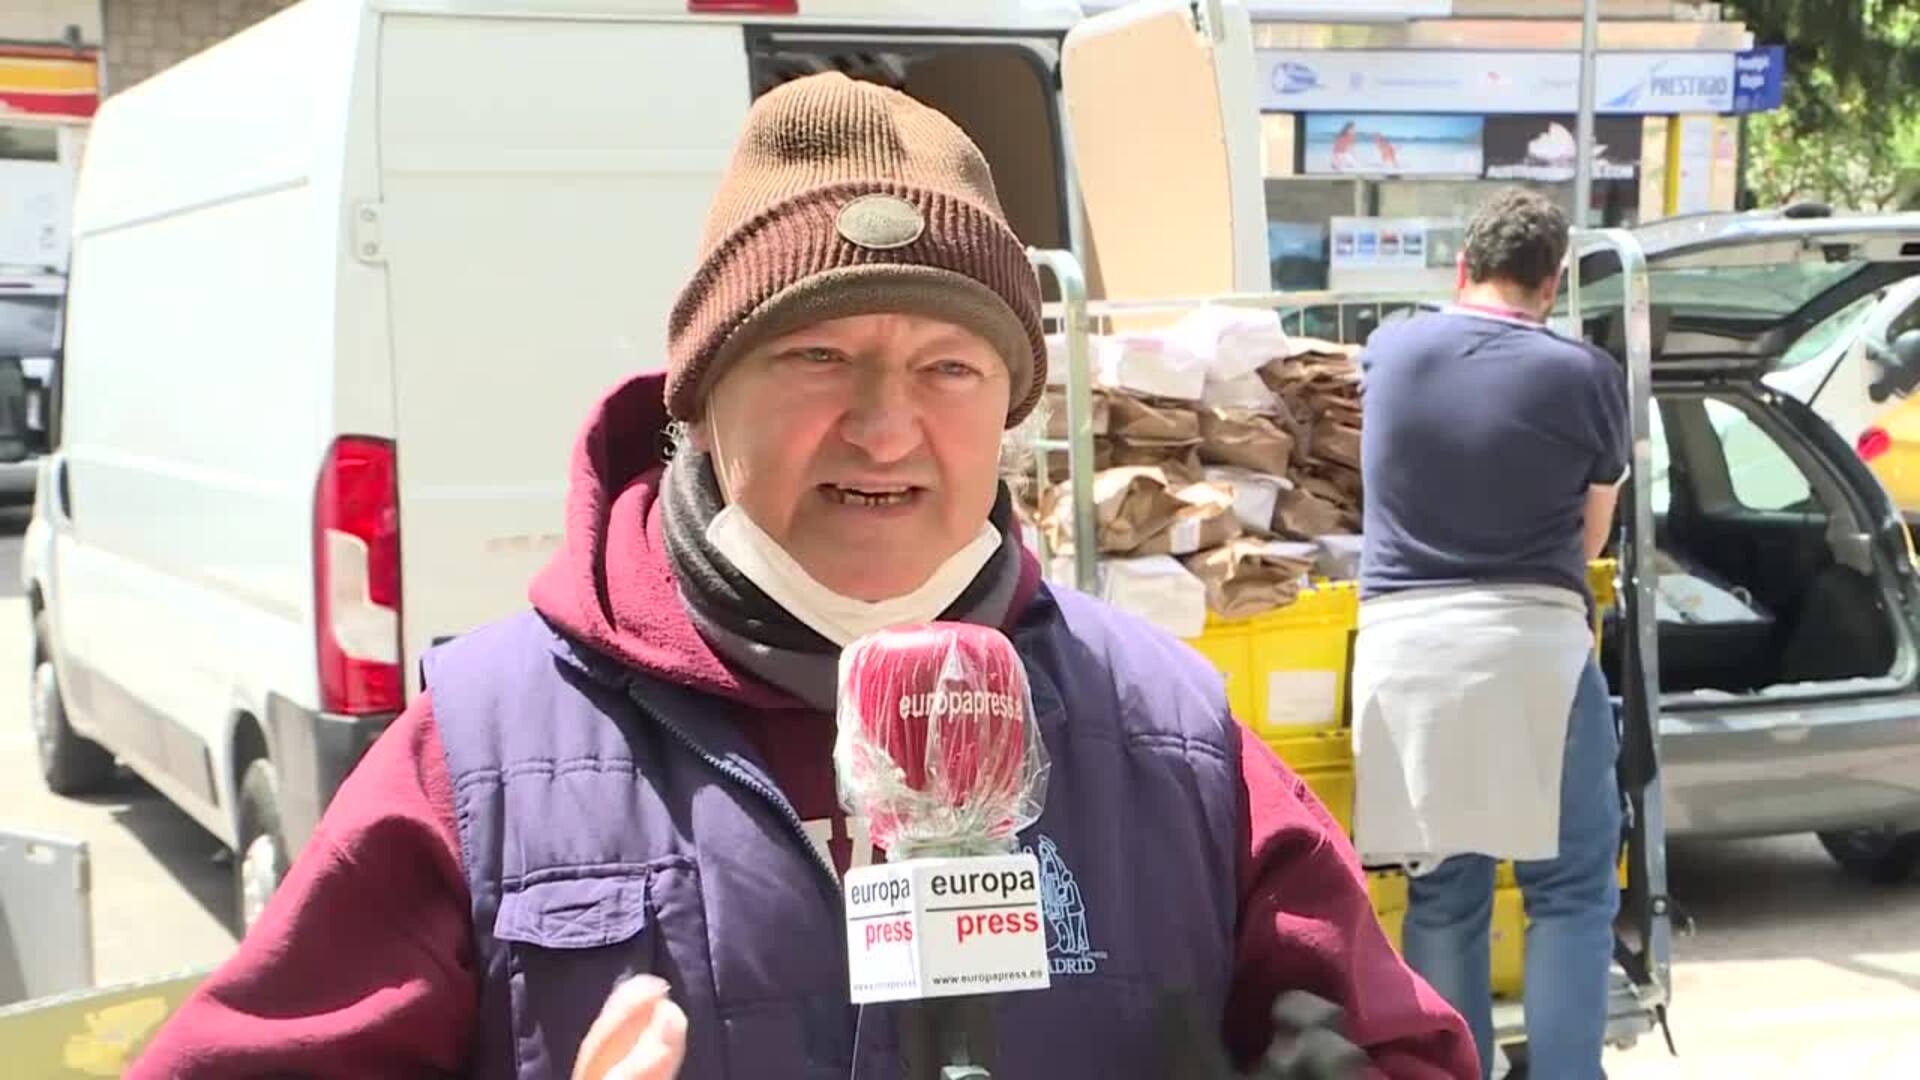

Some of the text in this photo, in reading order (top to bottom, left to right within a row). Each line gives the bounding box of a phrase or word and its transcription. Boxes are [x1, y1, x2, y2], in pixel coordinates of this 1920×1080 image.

[851, 877, 910, 907] europa
[931, 869, 1036, 898] europa
[865, 918, 913, 950] press
[957, 911, 1040, 943] press
[932, 969, 1044, 986] www.europapress.es
